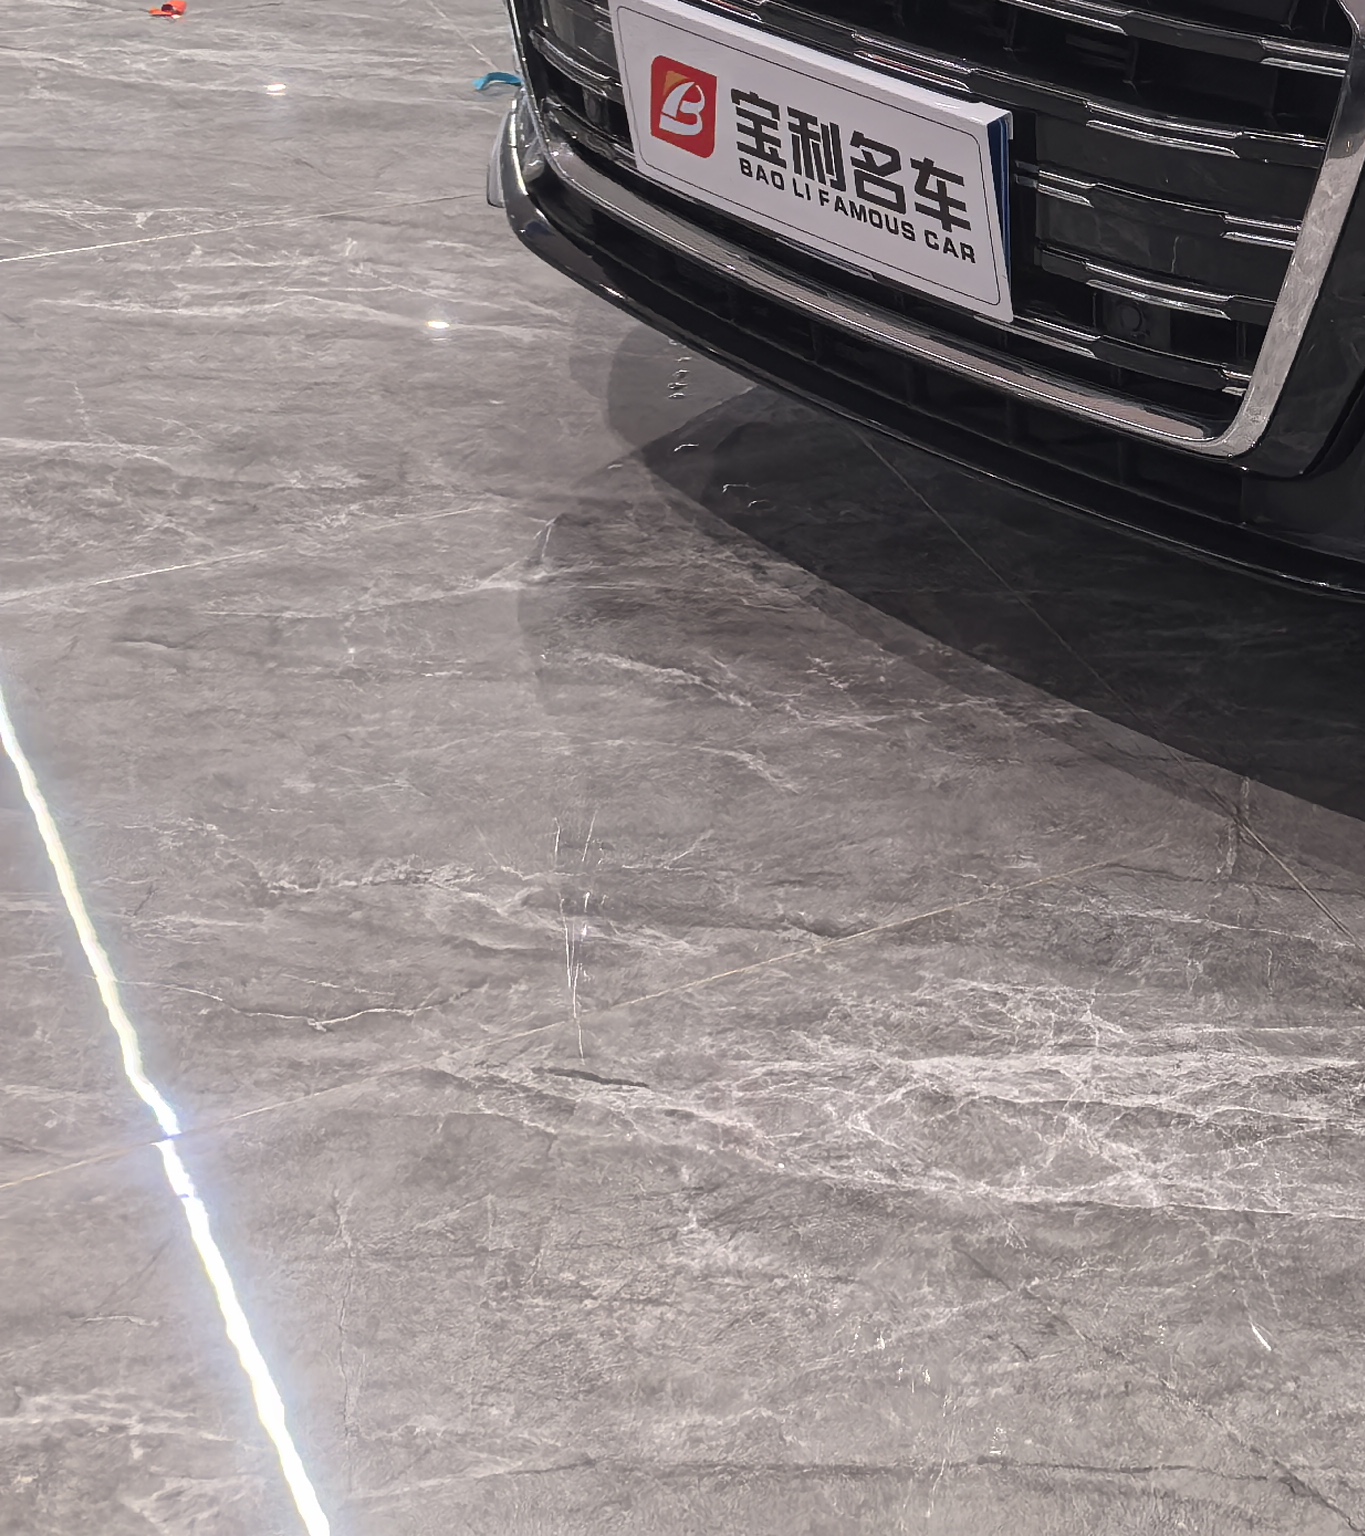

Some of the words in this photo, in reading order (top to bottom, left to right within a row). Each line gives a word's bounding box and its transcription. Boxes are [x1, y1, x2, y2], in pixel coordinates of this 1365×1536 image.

[731, 88, 972, 233] 宝利名车
[739, 157, 785, 191] BAO
[792, 179, 812, 201] LI
[818, 189, 916, 242] FAMOUS
[924, 229, 976, 264] CAR
